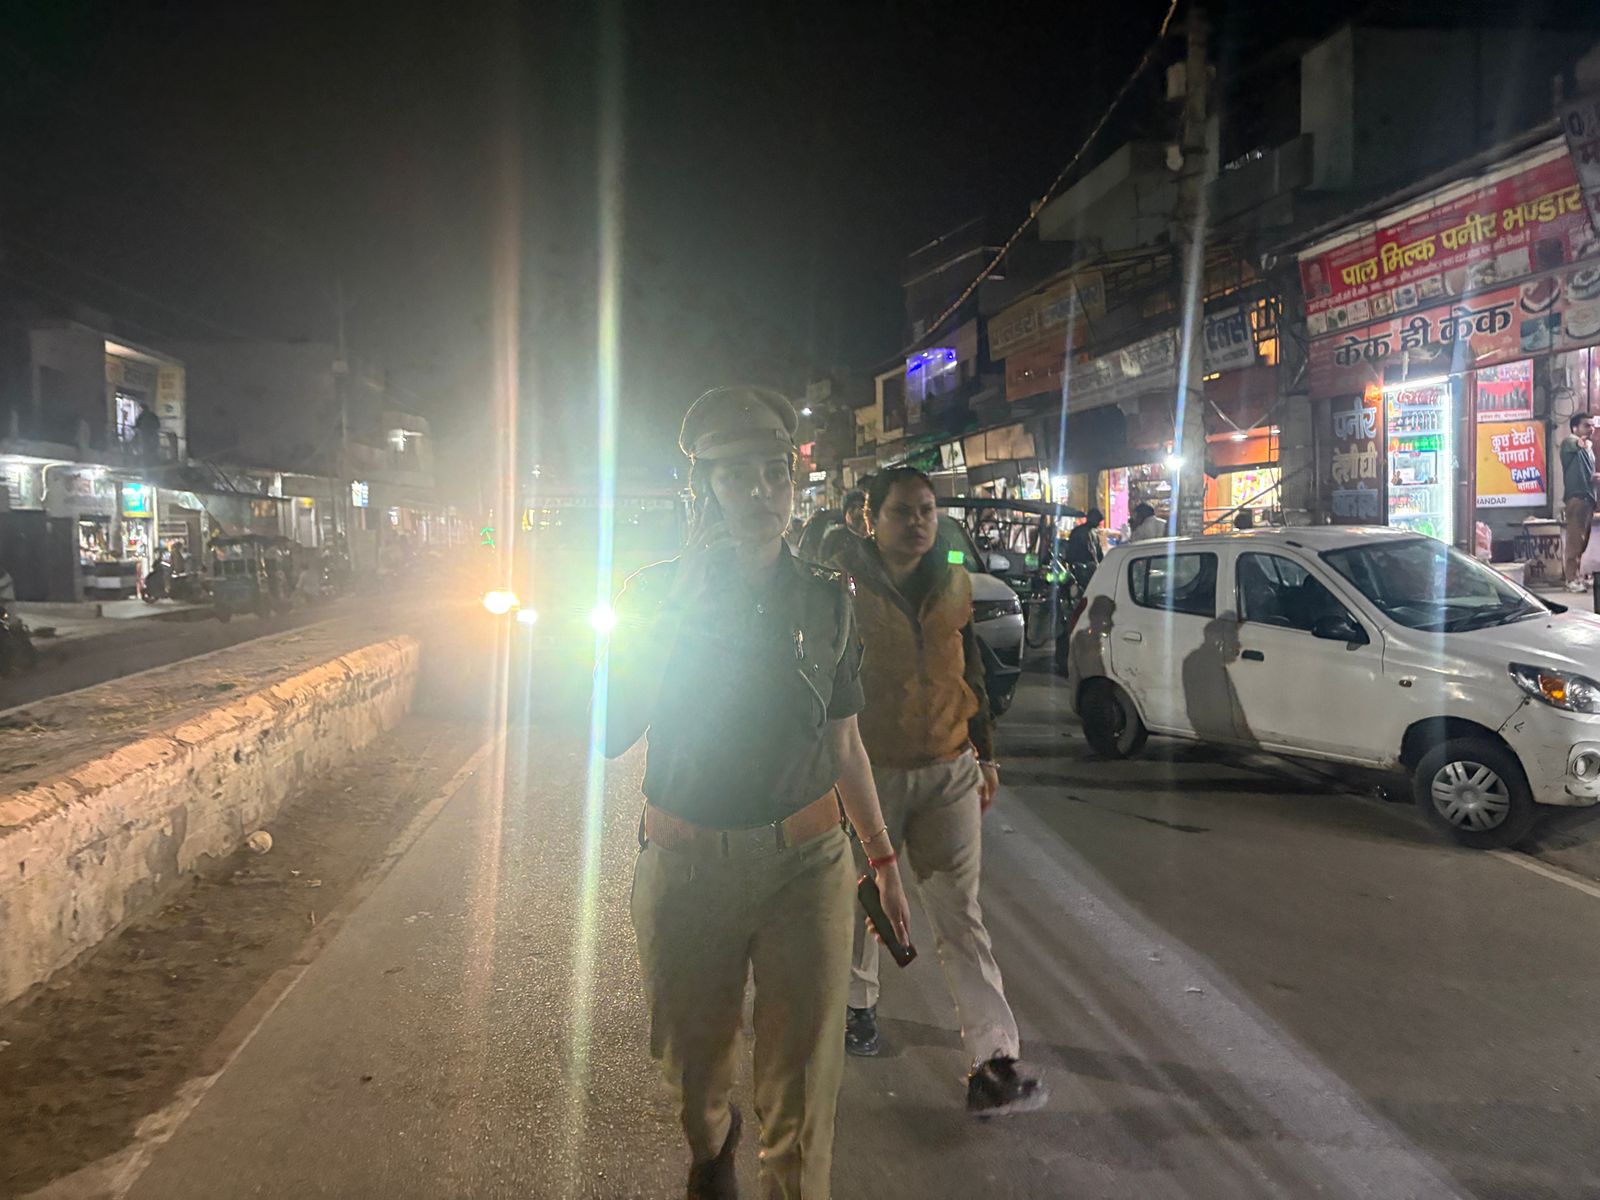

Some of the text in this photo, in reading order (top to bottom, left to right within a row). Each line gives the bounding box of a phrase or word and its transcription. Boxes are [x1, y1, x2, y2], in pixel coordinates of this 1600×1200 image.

[1341, 257, 1378, 286] पाल
[1380, 236, 1436, 274] मिल्क
[1440, 212, 1497, 250] पनीर
[1503, 184, 1582, 231] भण्डार
[1333, 334, 1393, 367] केक
[1400, 315, 1432, 352] ही
[1439, 299, 1515, 343] केक
[1334, 397, 1377, 441] पनीर
[1491, 427, 1535, 453] कुछ टेस्टी
[1511, 467, 1541, 481] FANTA
